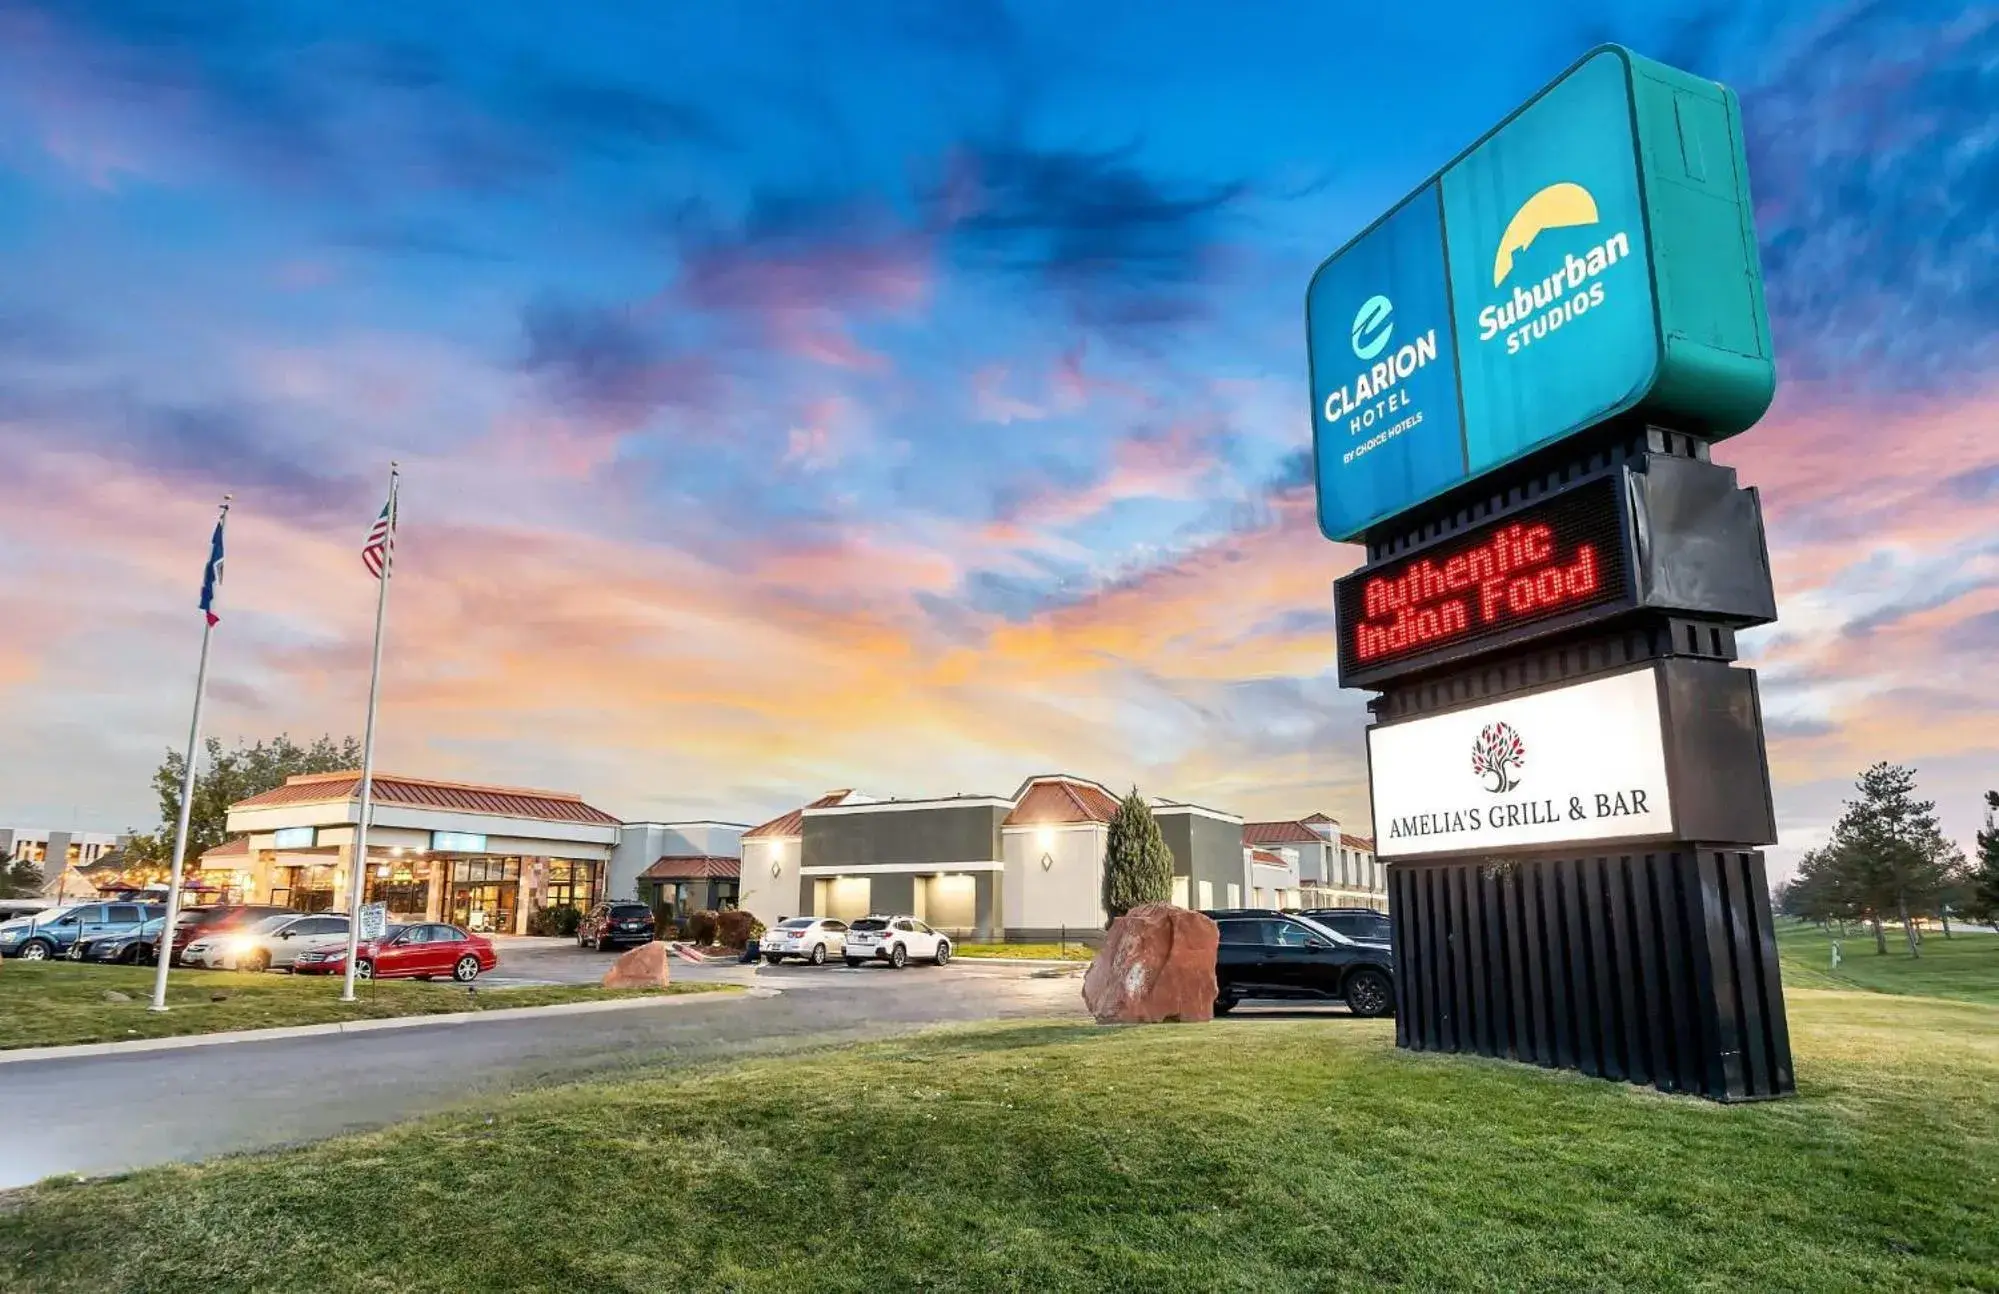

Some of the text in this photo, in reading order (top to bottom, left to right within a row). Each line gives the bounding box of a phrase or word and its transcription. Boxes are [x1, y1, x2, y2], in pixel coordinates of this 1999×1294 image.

[1478, 231, 1629, 341] Suburban
[1506, 281, 1605, 355] STUDIOS
[1324, 329, 1437, 422] CLARION
[1350, 389, 1410, 435] HOTEL
[1343, 411, 1423, 464] BY CHOICE HOTELS
[1356, 544, 1598, 660] Indian Food
[1365, 522, 1551, 618] Authentic
[1390, 789, 1650, 838] AMELIA'S GRILL & BAR
